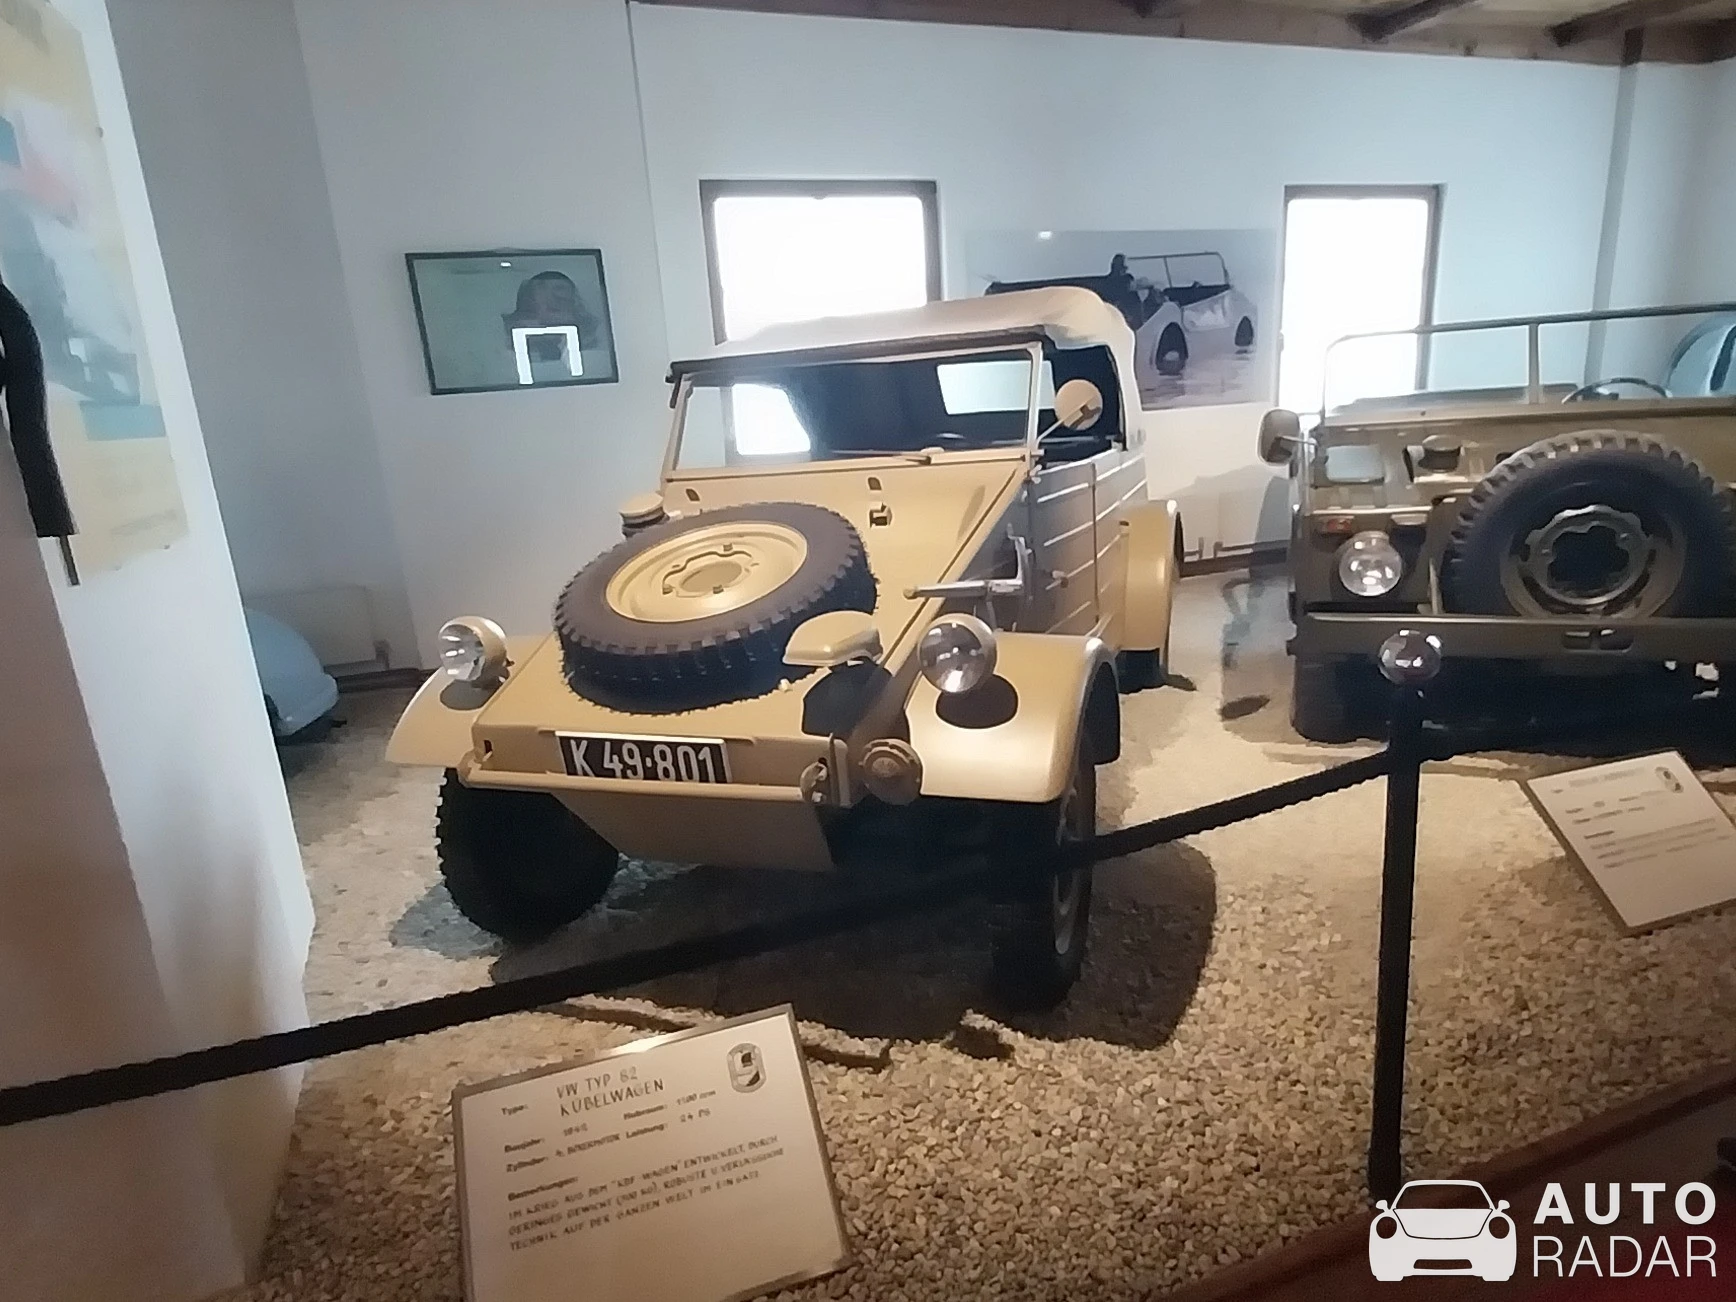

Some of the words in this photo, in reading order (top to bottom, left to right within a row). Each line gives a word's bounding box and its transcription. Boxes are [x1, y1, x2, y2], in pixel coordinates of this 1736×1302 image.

[570, 739, 595, 777] K
[556, 1082, 578, 1099] VW
[585, 1073, 611, 1091] TYP
